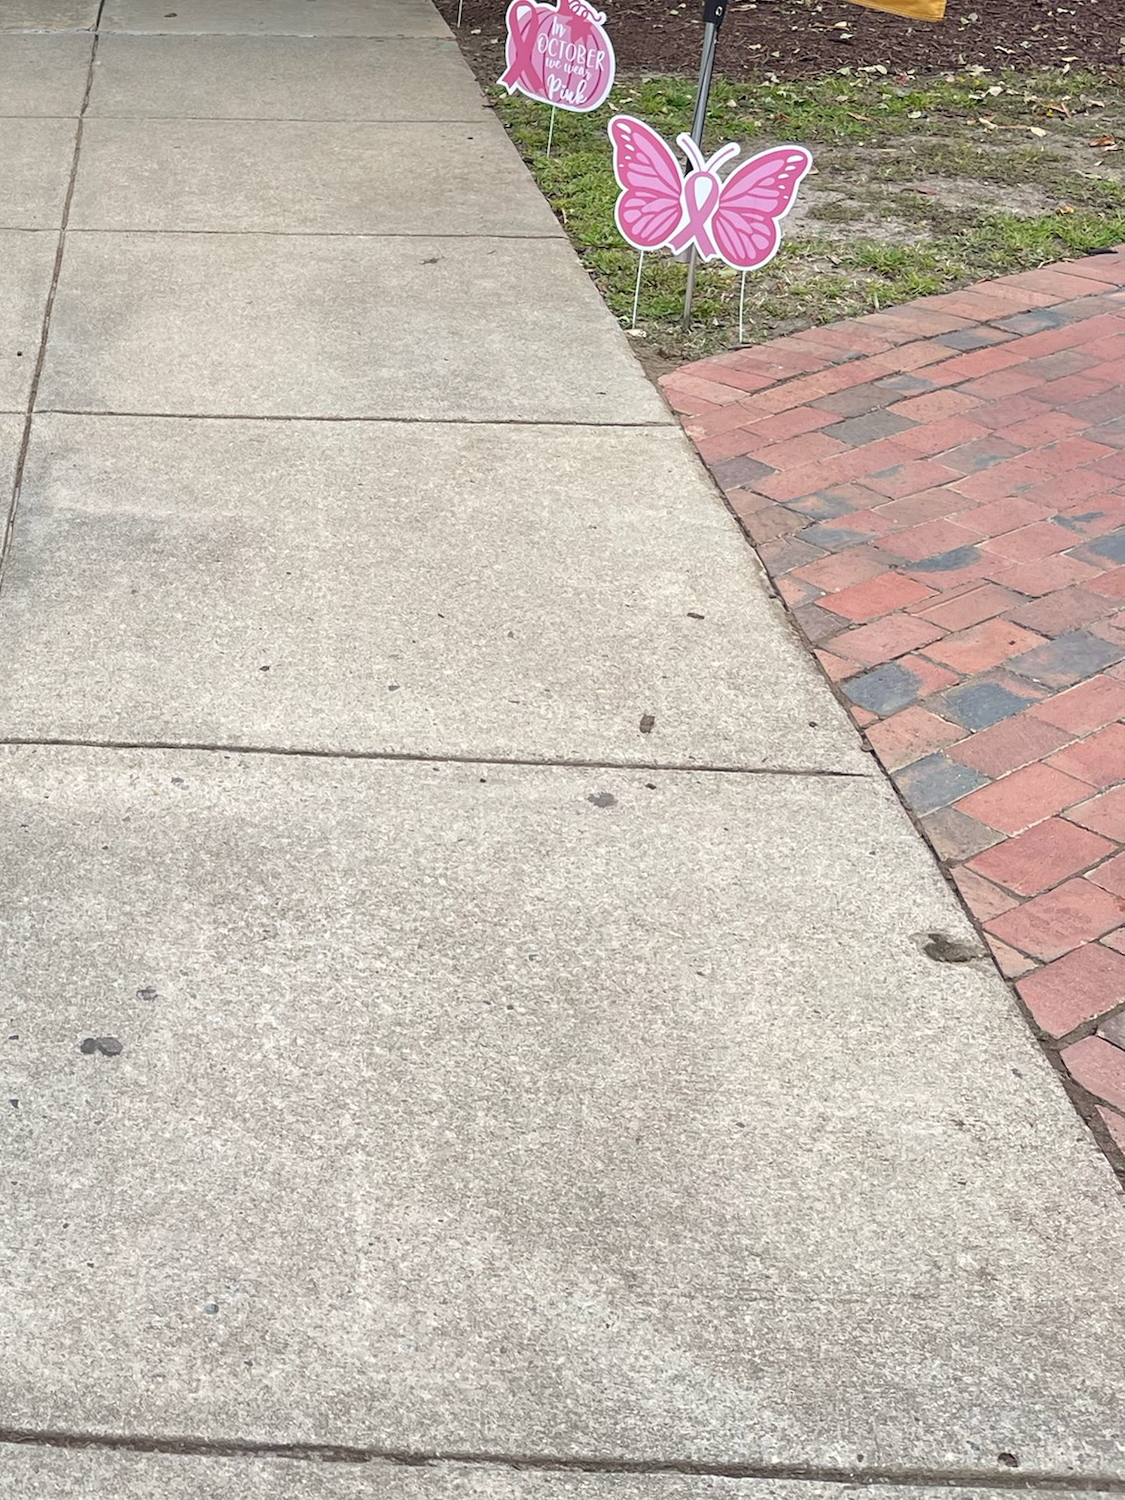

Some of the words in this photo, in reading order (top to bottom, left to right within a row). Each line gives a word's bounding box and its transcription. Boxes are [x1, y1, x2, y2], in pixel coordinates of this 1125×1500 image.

[551, 15, 567, 38] In
[537, 32, 606, 72] OCTOBER
[545, 56, 562, 69] we
[563, 61, 592, 80] wear
[546, 73, 587, 104] Pink
